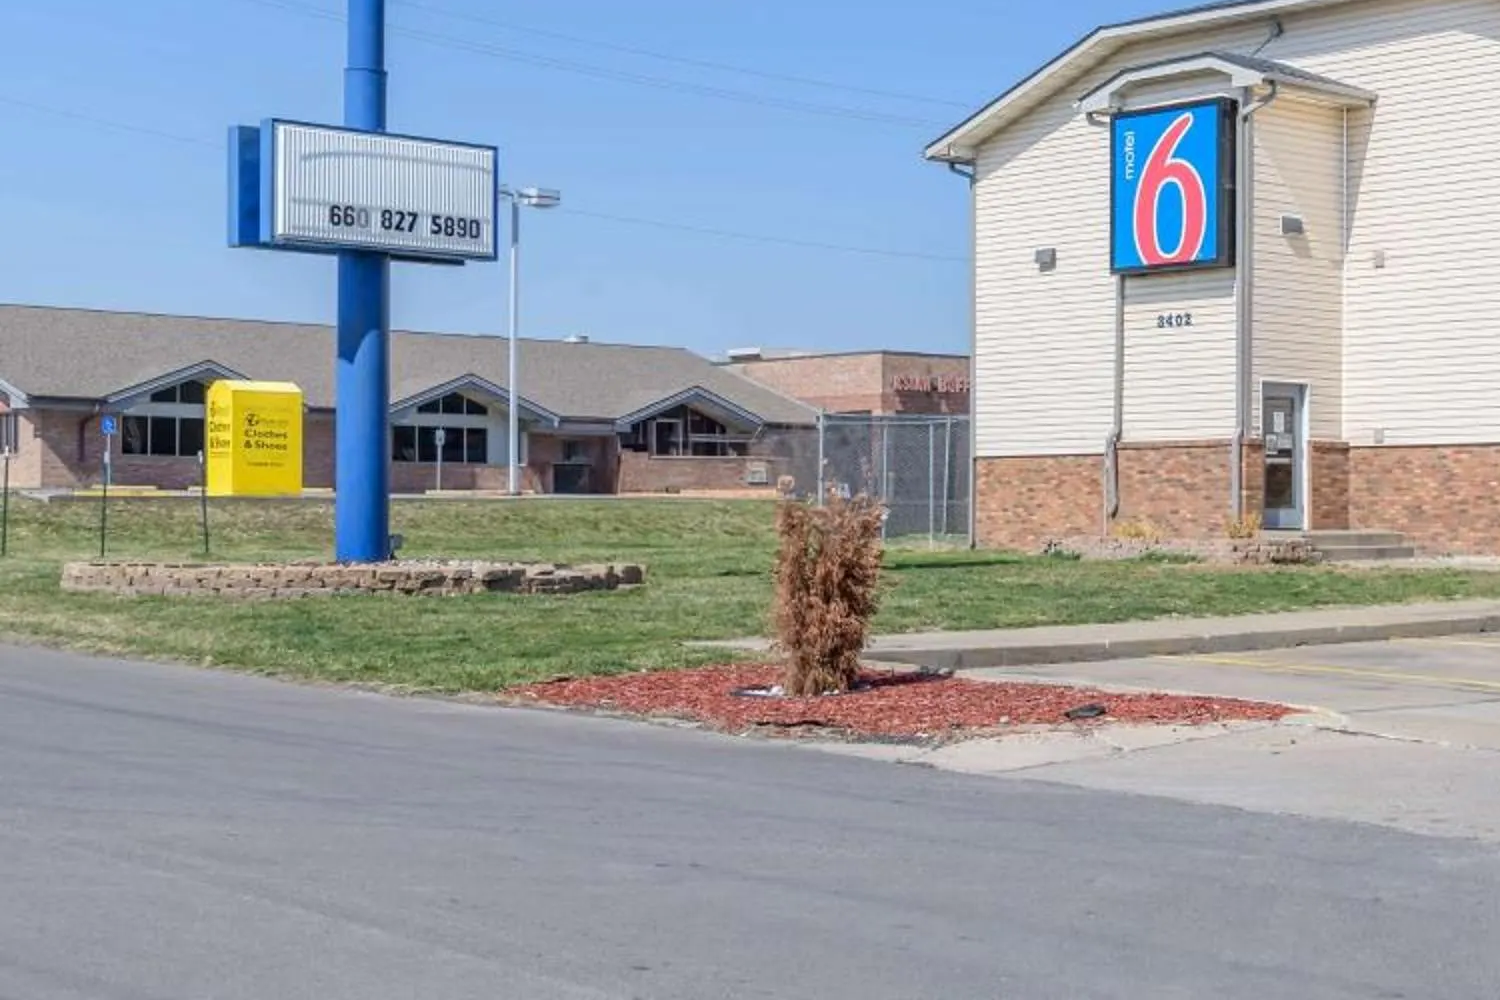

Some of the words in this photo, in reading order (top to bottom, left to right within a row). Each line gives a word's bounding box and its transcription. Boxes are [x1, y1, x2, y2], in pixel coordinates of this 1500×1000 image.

[330, 204, 369, 229] 660
[381, 209, 419, 233] 827
[431, 214, 481, 239] 5890
[1123, 131, 1136, 180] motel
[1133, 112, 1207, 265] 6
